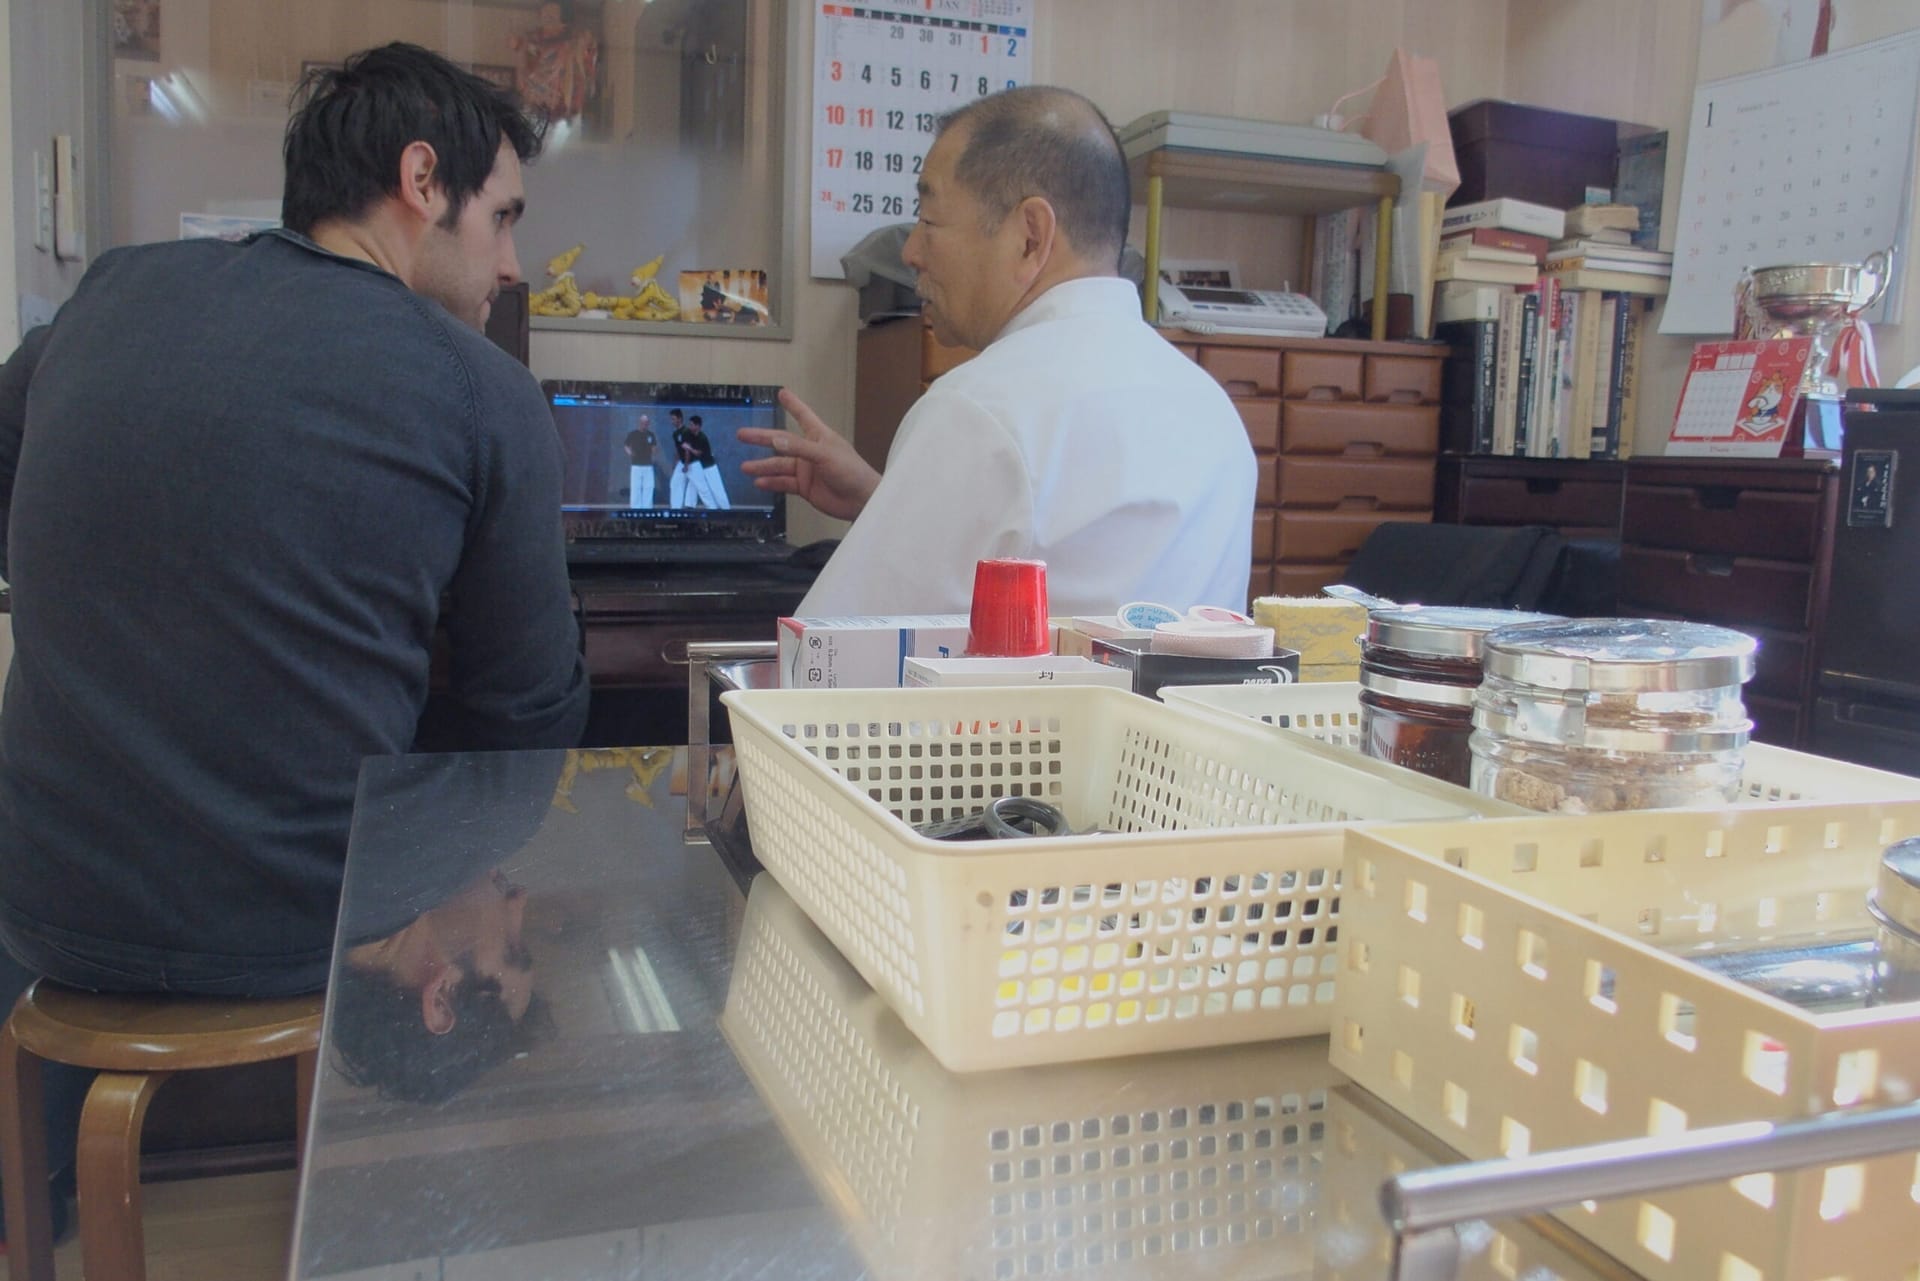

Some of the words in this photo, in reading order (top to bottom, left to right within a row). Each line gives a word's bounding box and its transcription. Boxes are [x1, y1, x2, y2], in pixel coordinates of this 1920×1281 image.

[919, 28, 934, 43] 30
[949, 32, 961, 46] 31
[981, 34, 988, 54] 1
[1007, 38, 1017, 57] 2
[831, 61, 842, 81] 3
[861, 64, 871, 84] 4
[891, 67, 901, 87] 5
[921, 70, 930, 90] 6
[950, 74, 958, 93] 7
[978, 77, 988, 96] 8
[825, 105, 845, 125] 10
[857, 108, 873, 128] 11
[886, 110, 904, 130] 12
[915, 113, 933, 133] 13
[1705, 101, 1713, 128] 1
[826, 148, 843, 168] 17
[855, 151, 873, 171] 18
[884, 153, 903, 173] 19
[912, 155, 922, 175] 2
[852, 193, 873, 214] 25
[882, 196, 903, 216] 26
[912, 198, 920, 217] 2
